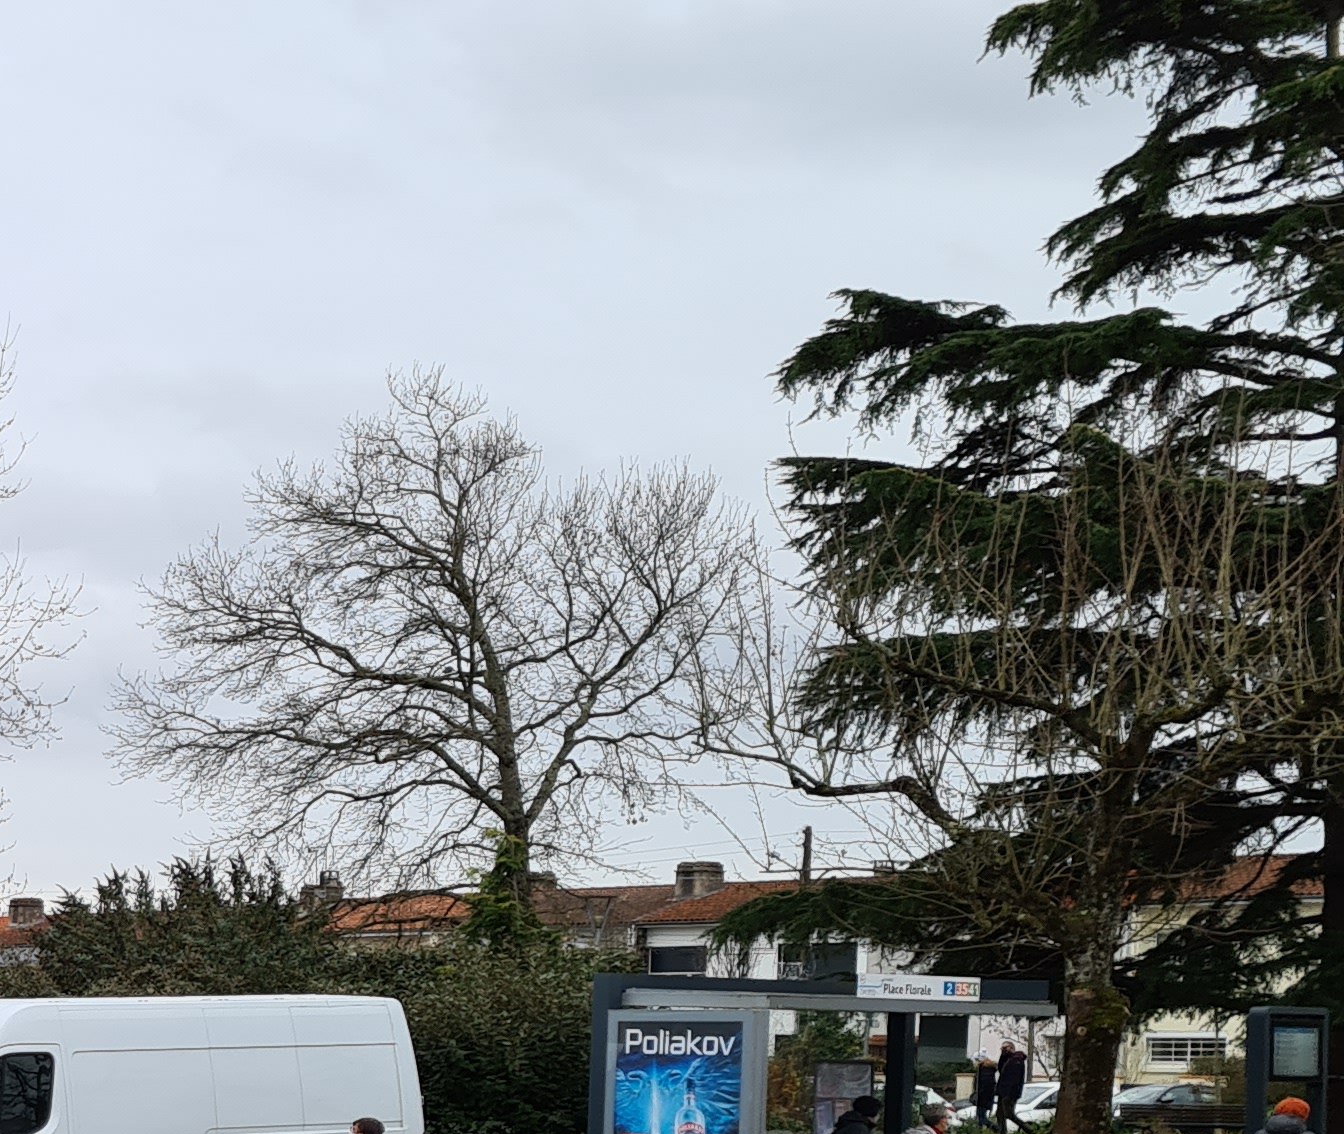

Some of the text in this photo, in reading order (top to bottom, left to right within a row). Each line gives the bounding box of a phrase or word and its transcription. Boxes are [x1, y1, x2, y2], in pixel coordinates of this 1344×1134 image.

[883, 983, 903, 995] Place
[905, 983, 932, 996] Florale
[946, 983, 979, 996] 2 35 41
[625, 1028, 736, 1056] Poliakov
